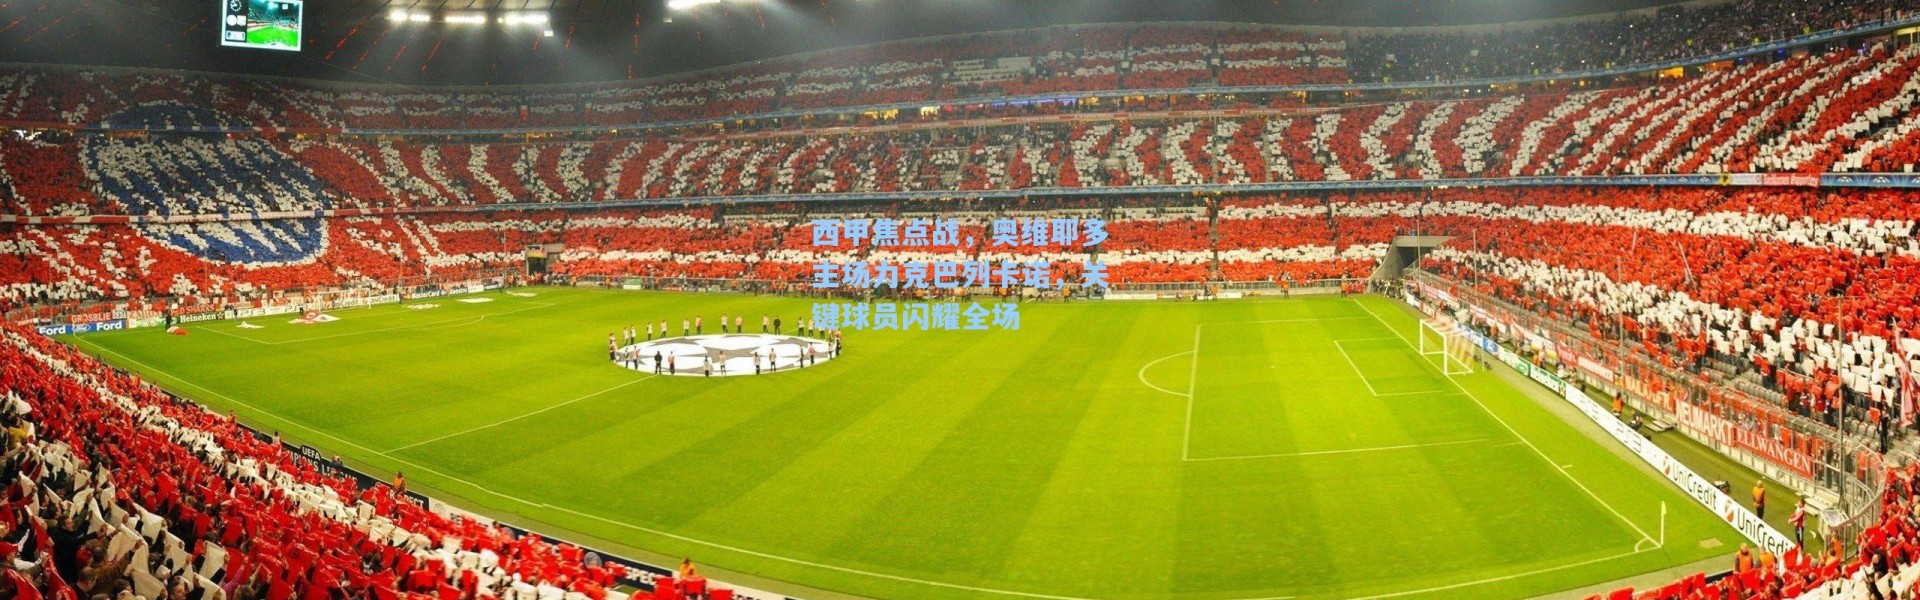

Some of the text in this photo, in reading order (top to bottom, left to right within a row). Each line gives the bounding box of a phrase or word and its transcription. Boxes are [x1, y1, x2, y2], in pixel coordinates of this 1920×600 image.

[38, 325, 66, 335] Ford
[96, 320, 123, 331] Ford
[180, 313, 217, 323] Heineken
[301, 446, 321, 461] UEFA
[1676, 398, 1812, 478] NEUMARKT ELLWANGEN
[1671, 463, 1718, 510] UniCredit
[1737, 510, 1793, 557] UniCred
